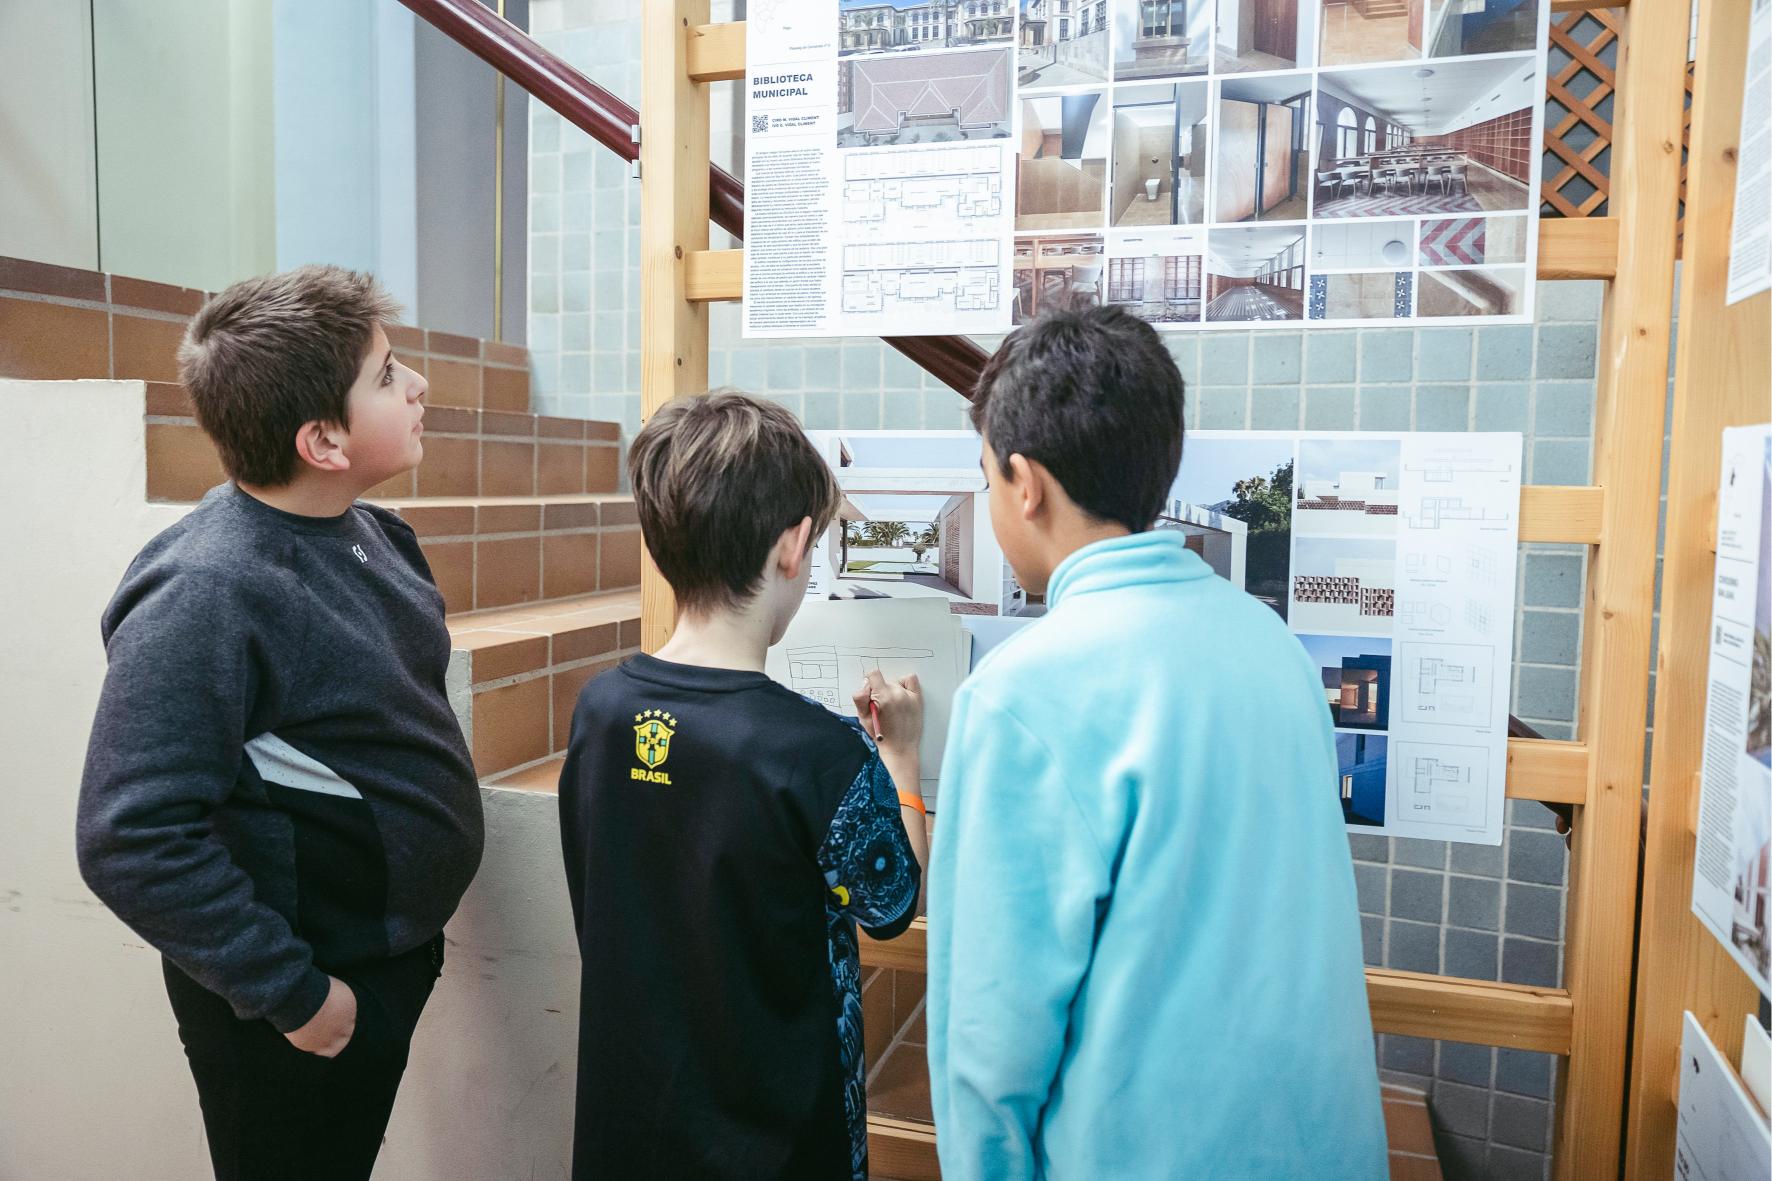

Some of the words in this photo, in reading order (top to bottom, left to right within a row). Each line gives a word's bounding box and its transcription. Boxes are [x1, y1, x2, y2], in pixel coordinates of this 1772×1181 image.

[753, 73, 813, 85] BIBLIOTECA
[753, 87, 808, 98] MUNICIPAL
[631, 768, 672, 785] BRASIL
